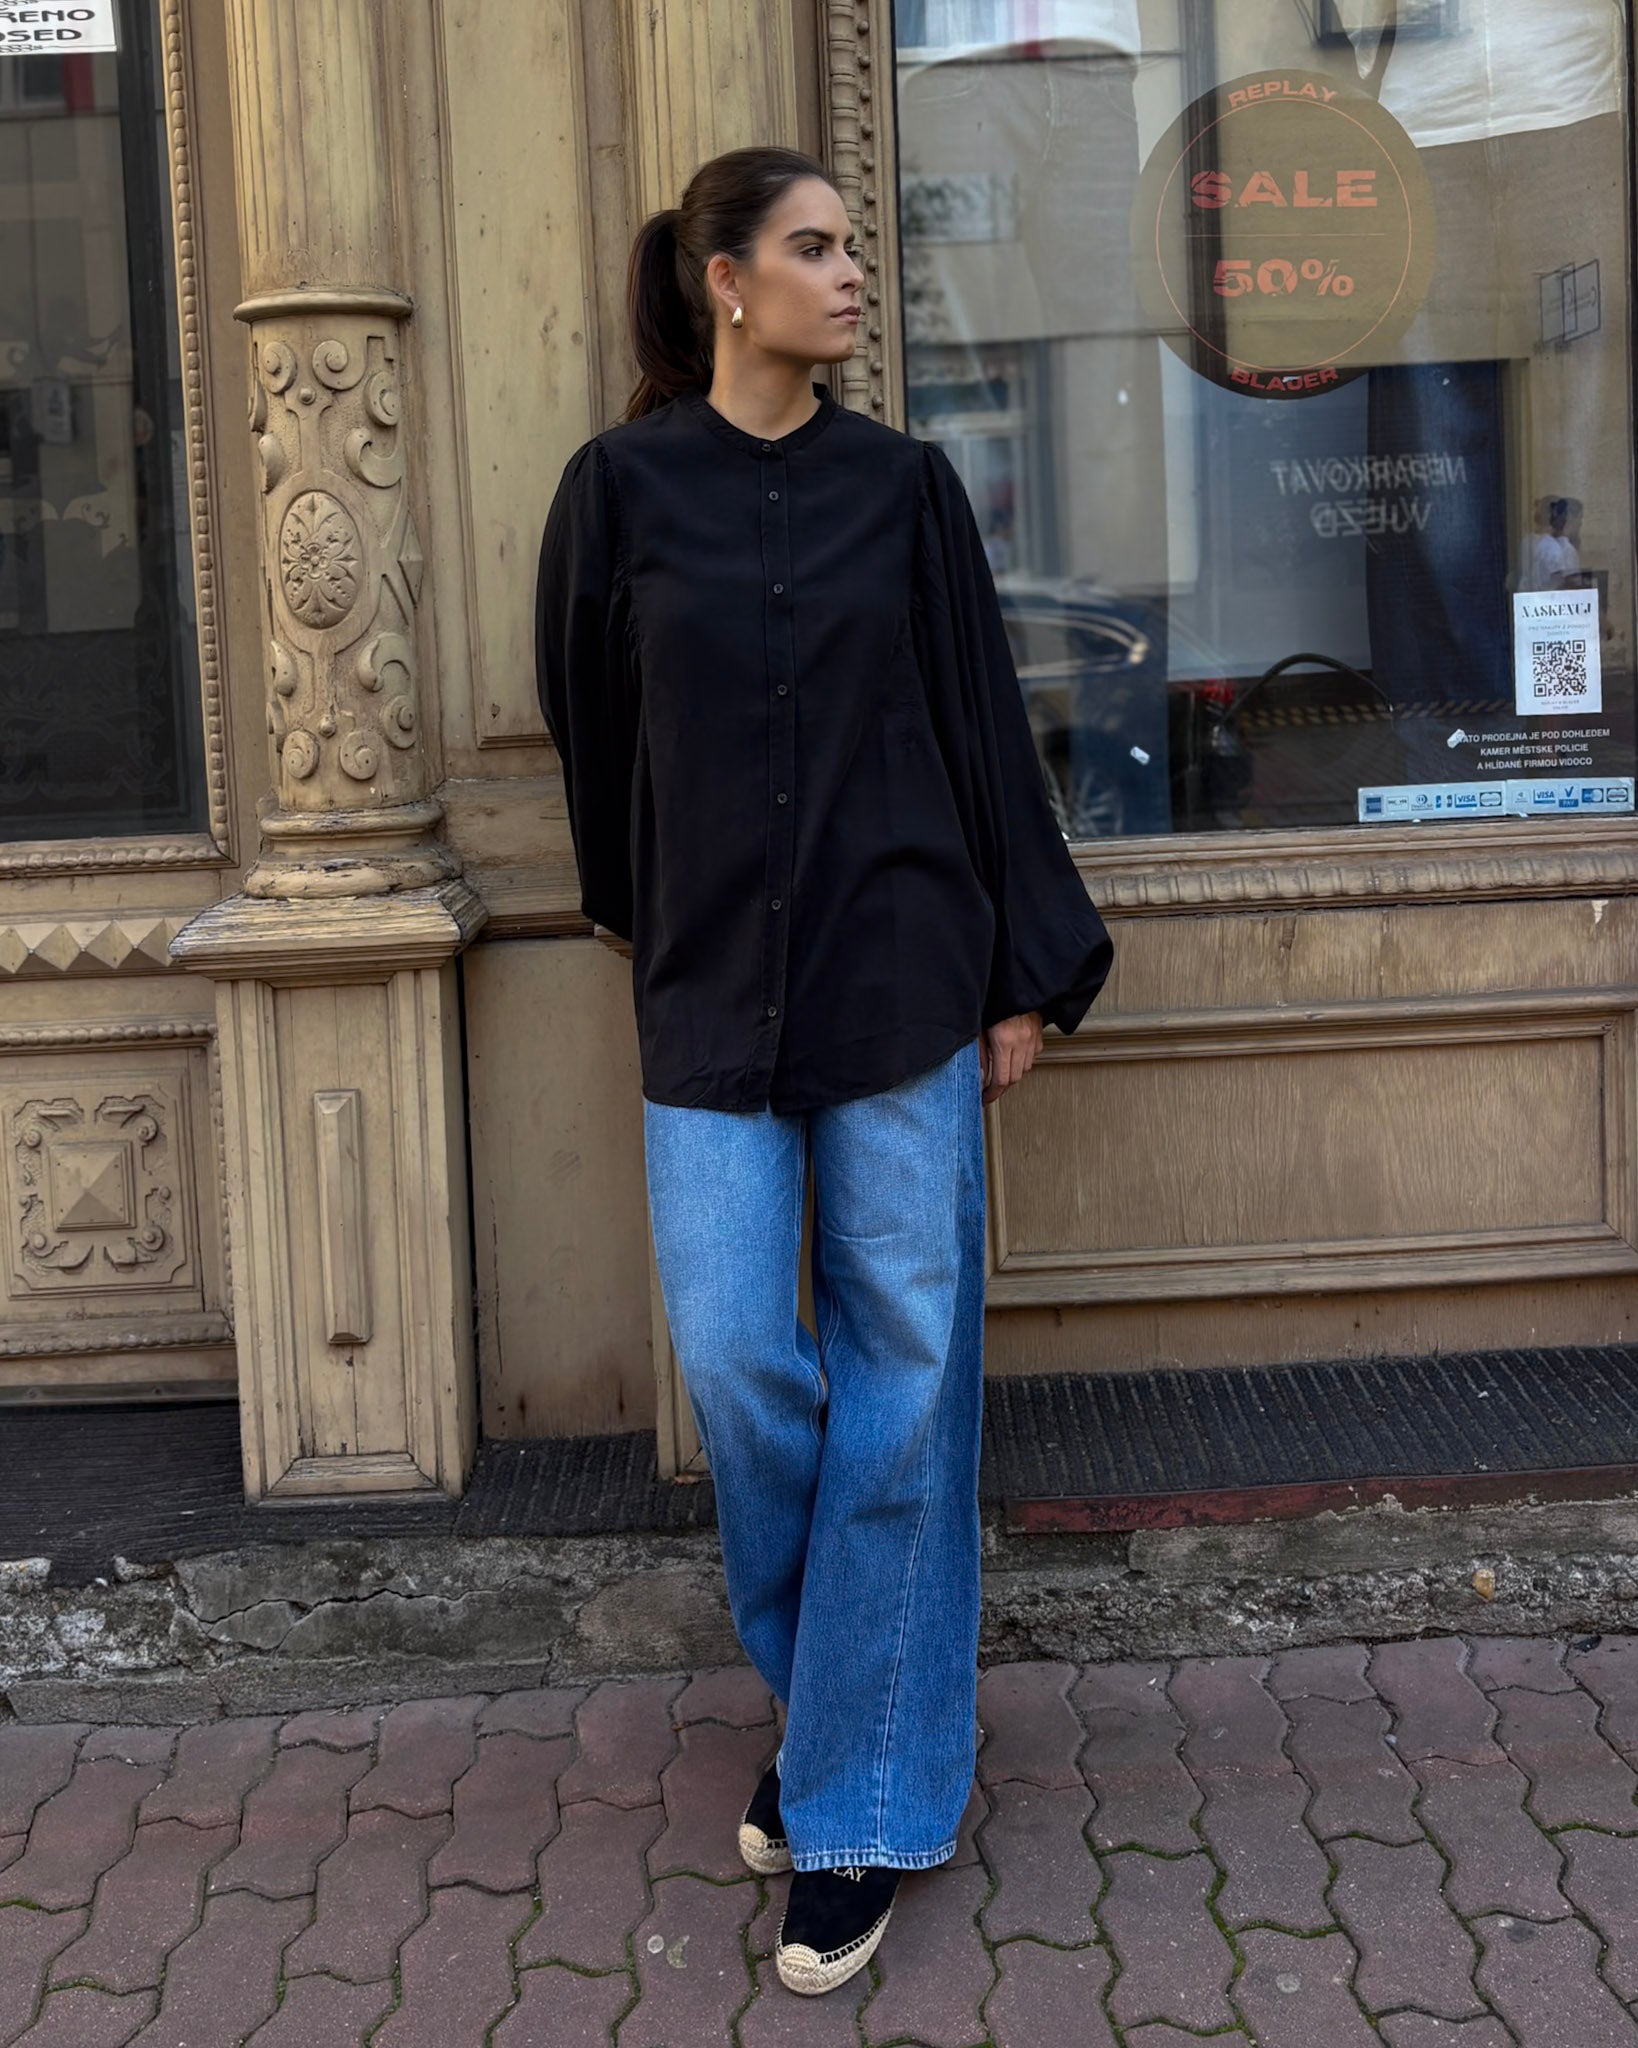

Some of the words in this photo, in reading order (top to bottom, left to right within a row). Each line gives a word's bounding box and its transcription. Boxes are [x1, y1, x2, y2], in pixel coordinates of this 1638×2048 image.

[0, 29, 82, 42] SED
[1228, 81, 1338, 107] REPLAY
[1191, 170, 1378, 209] SALE
[1213, 258, 1354, 297] 50%
[1231, 366, 1338, 390] BLAUER
[1522, 603, 1591, 618] NASKENUJ
[1459, 734, 1480, 743] ATO
[1482, 732, 1528, 742] PRODEJNA
[1529, 731, 1540, 740] JE
[1541, 730, 1560, 739] POD
[1562, 728, 1610, 739] DOHLEDEM
[1480, 746, 1511, 756] KAMER
[1554, 743, 1589, 752] POLICIE
[1477, 761, 1484, 770] A
[1485, 759, 1522, 770] HLÍDANÉ
[1523, 759, 1558, 769] FIRMOU
[1457, 794, 1476, 803] VISA
[1536, 790, 1555, 799] VISA
